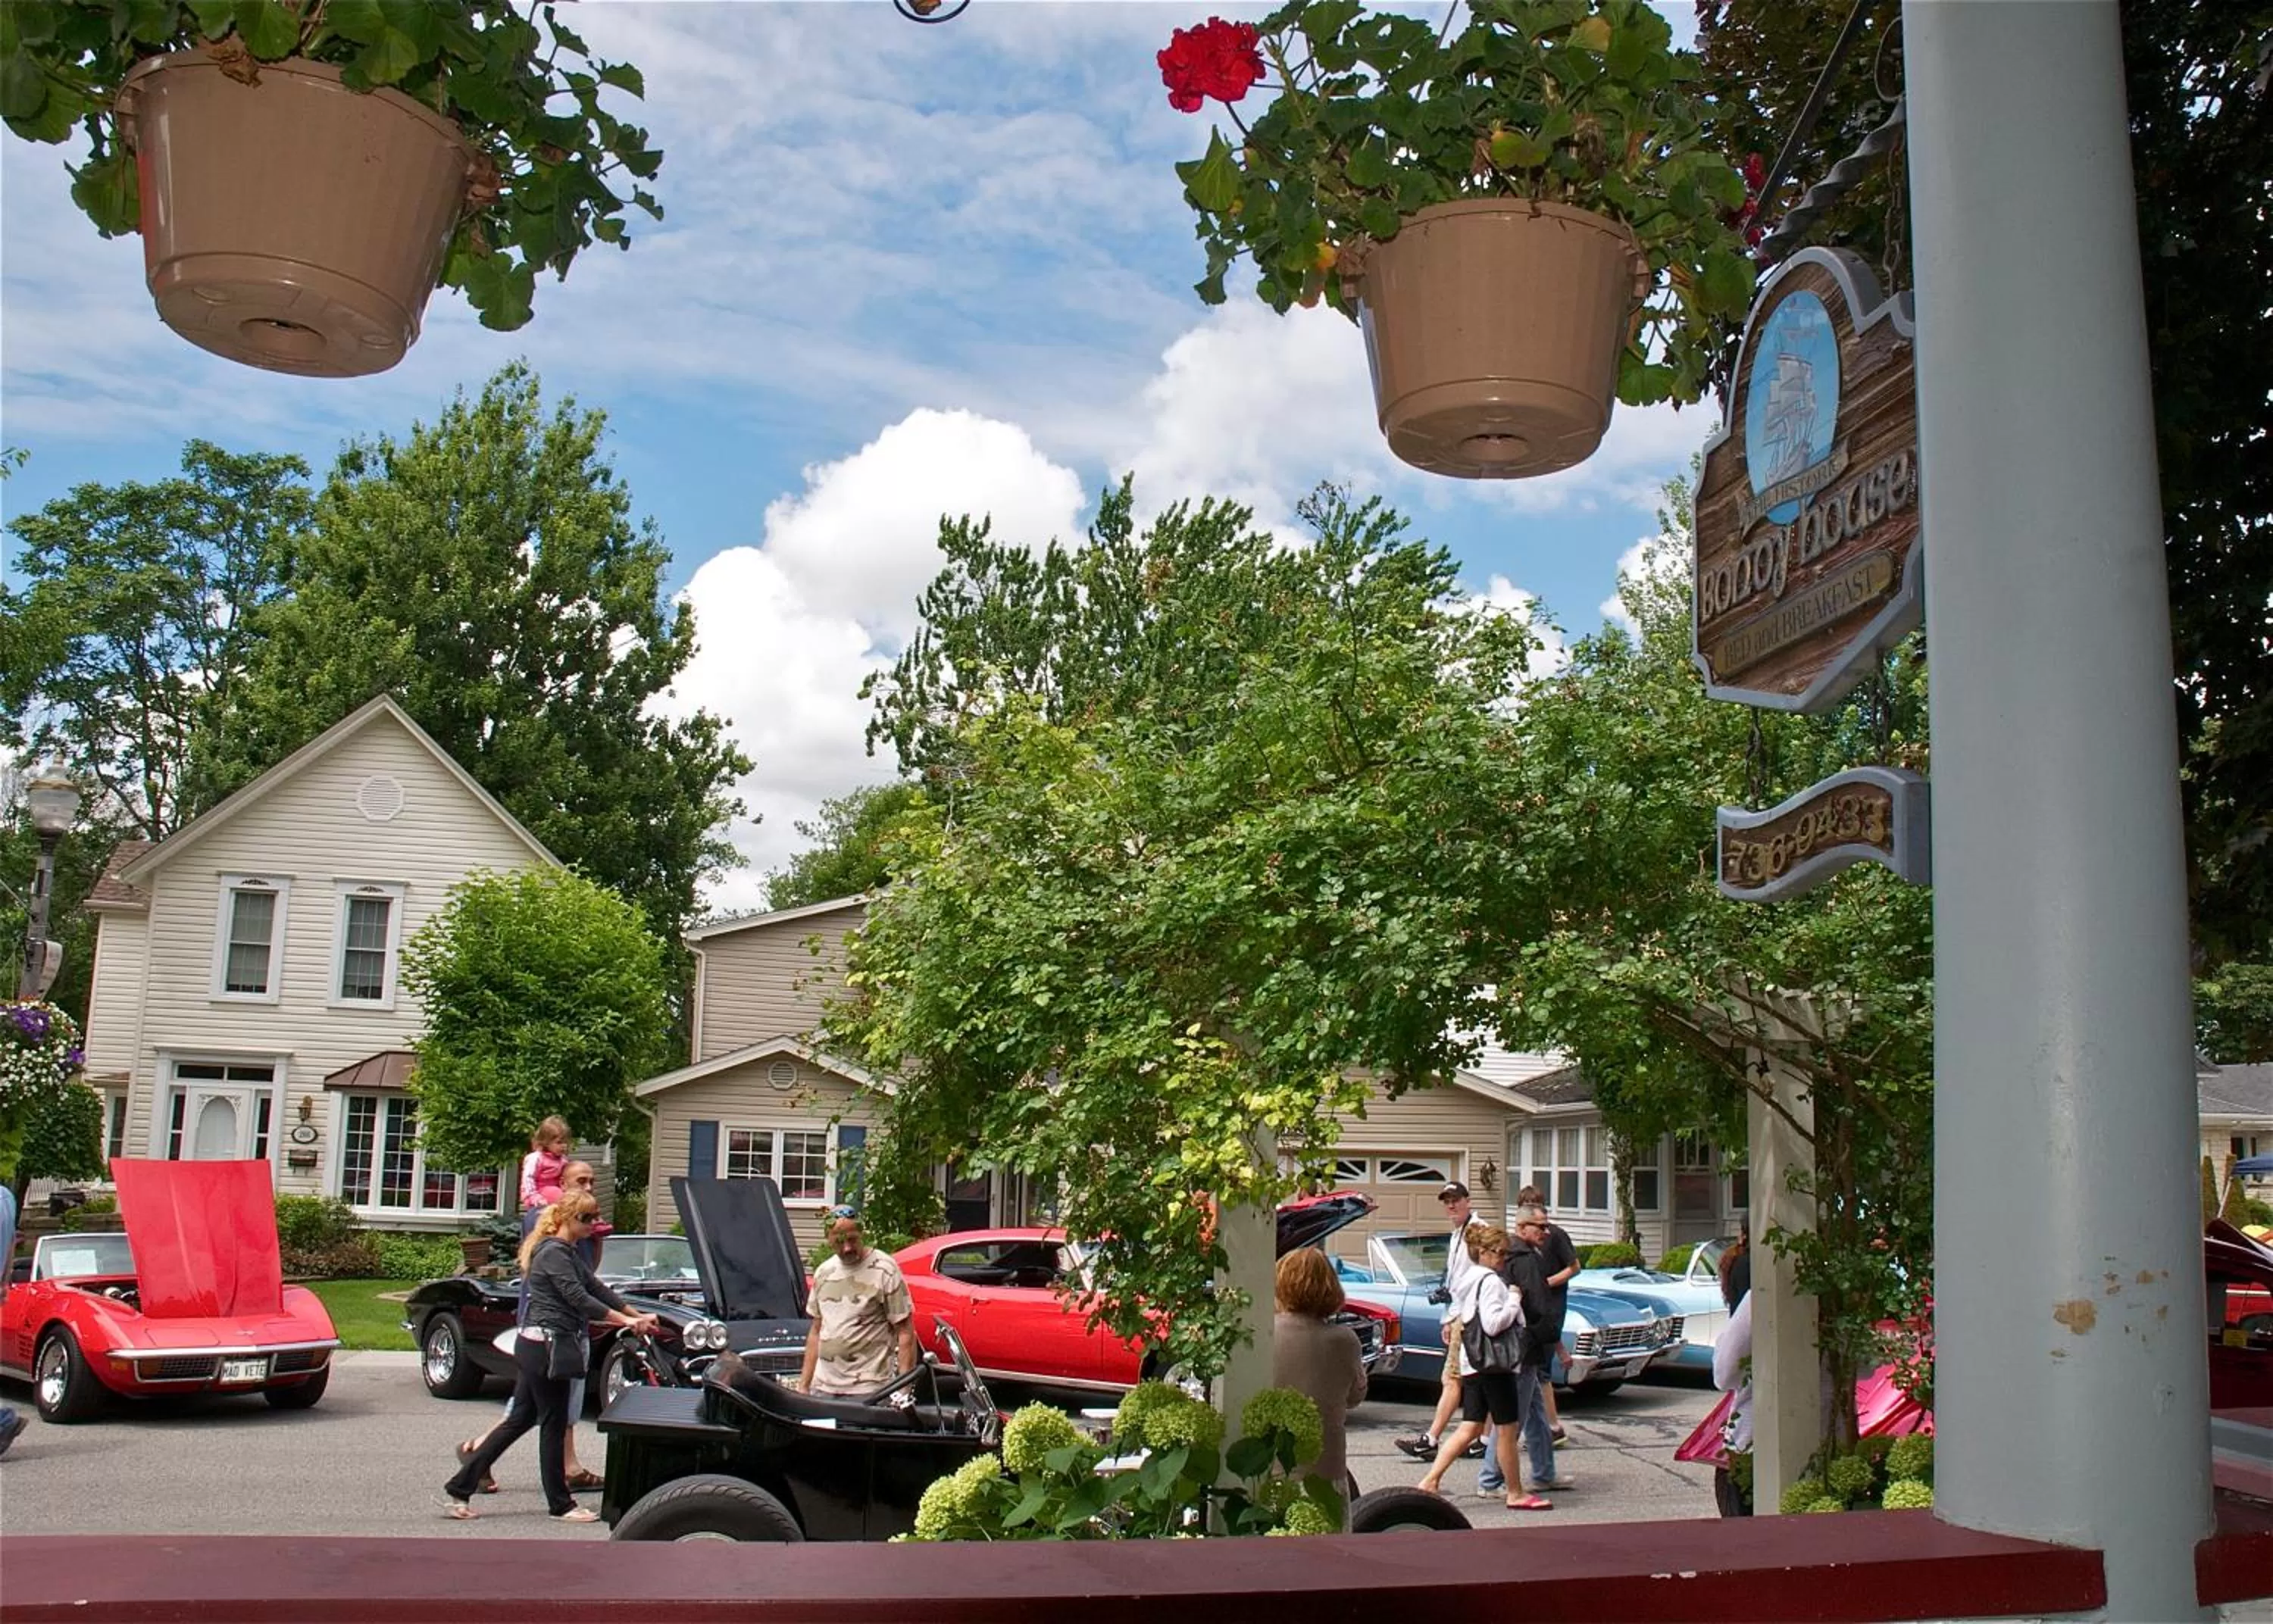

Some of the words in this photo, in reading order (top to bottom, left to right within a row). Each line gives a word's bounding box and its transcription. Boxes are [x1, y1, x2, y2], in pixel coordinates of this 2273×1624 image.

[1774, 458, 1841, 504] HISTORIC
[1724, 633, 1751, 670] BED
[1781, 568, 1874, 639] BREAKFAST
[1727, 796, 1887, 880] 736-9433
